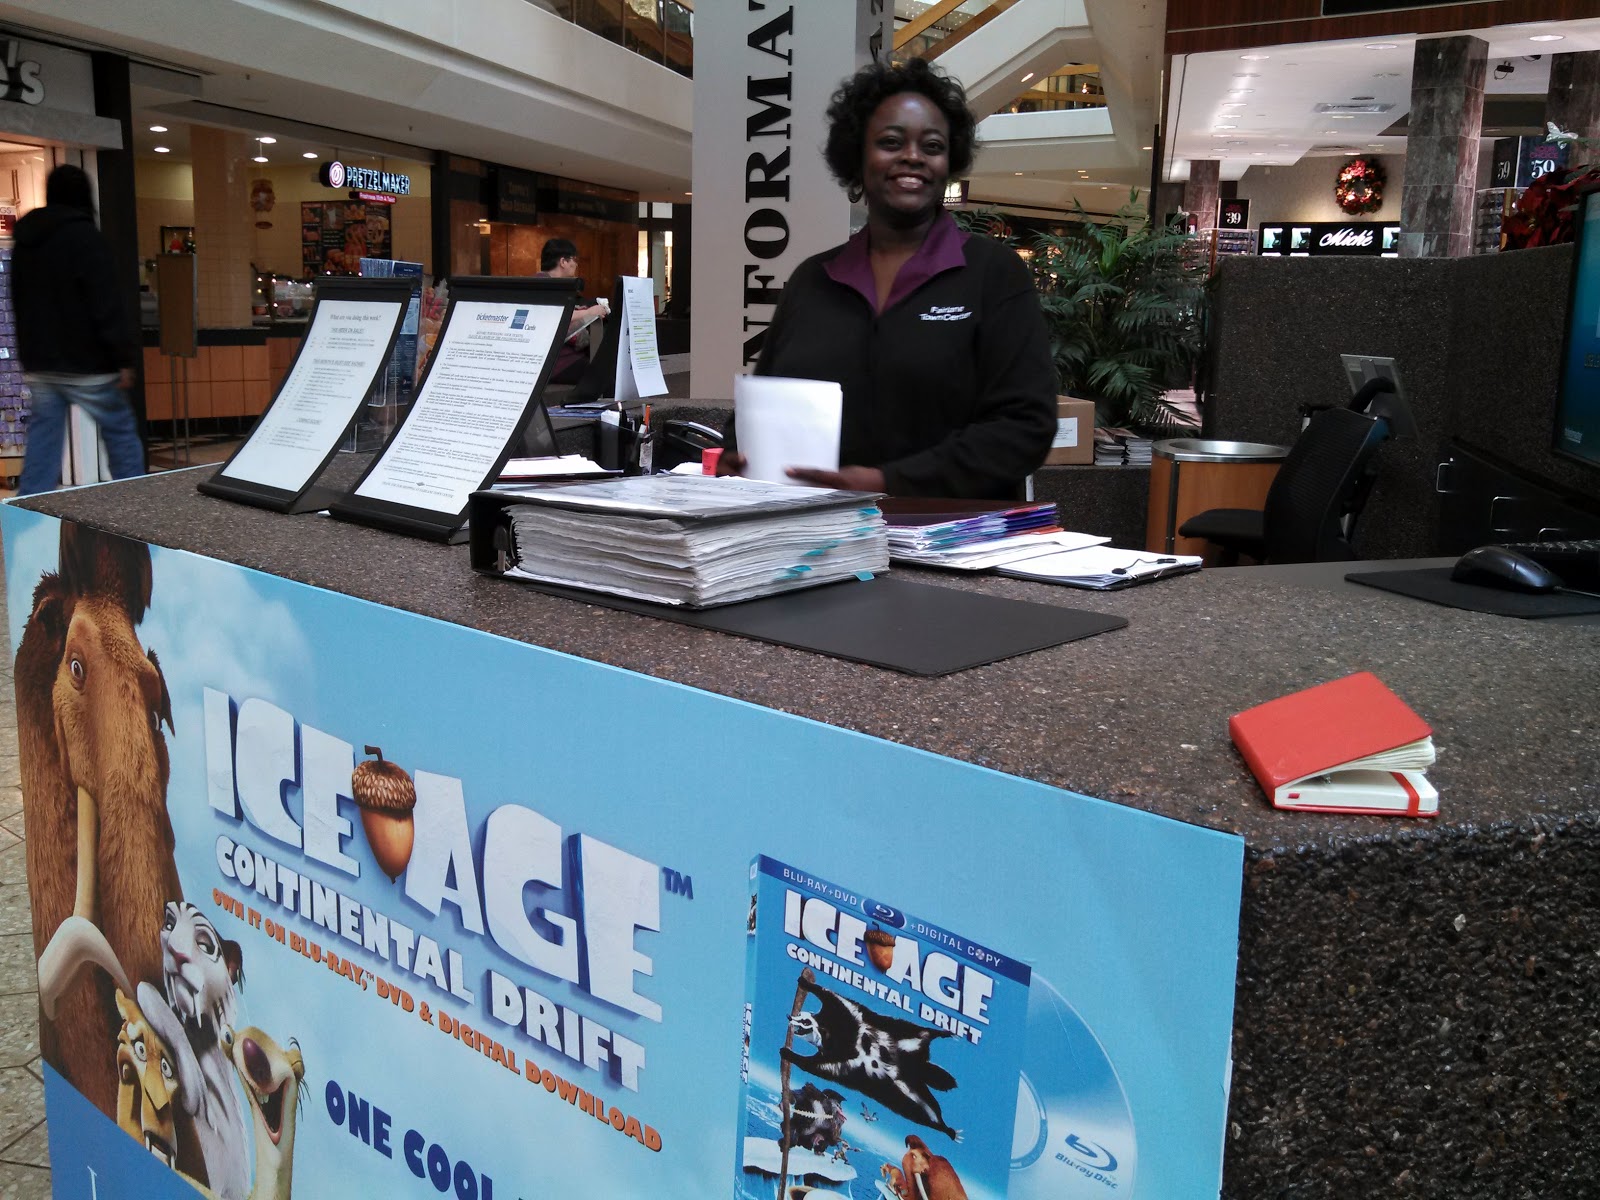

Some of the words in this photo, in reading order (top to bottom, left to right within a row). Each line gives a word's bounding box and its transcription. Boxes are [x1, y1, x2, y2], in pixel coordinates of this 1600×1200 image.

[346, 166, 410, 194] PRETZELMAKER
[742, 0, 793, 376] NFORMA
[203, 686, 361, 878] ICE
[405, 769, 662, 1023] AGE
[212, 888, 244, 921] OWN
[248, 907, 262, 931] IT
[265, 918, 286, 945] ON
[376, 976, 415, 1013] DVD
[419, 1001, 434, 1026] &
[438, 1010, 521, 1075] DIGITAL
[525, 1059, 663, 1153] DOWNLOAD
[216, 835, 475, 1006] CONTINENTAL
[491, 969, 646, 1094] DRIFT
[784, 888, 868, 968] ICE
[885, 935, 995, 1026] AGE
[786, 943, 915, 1014] CONTINENTAL
[920, 1005, 983, 1046] DRIFT
[325, 1080, 393, 1160] ONE
